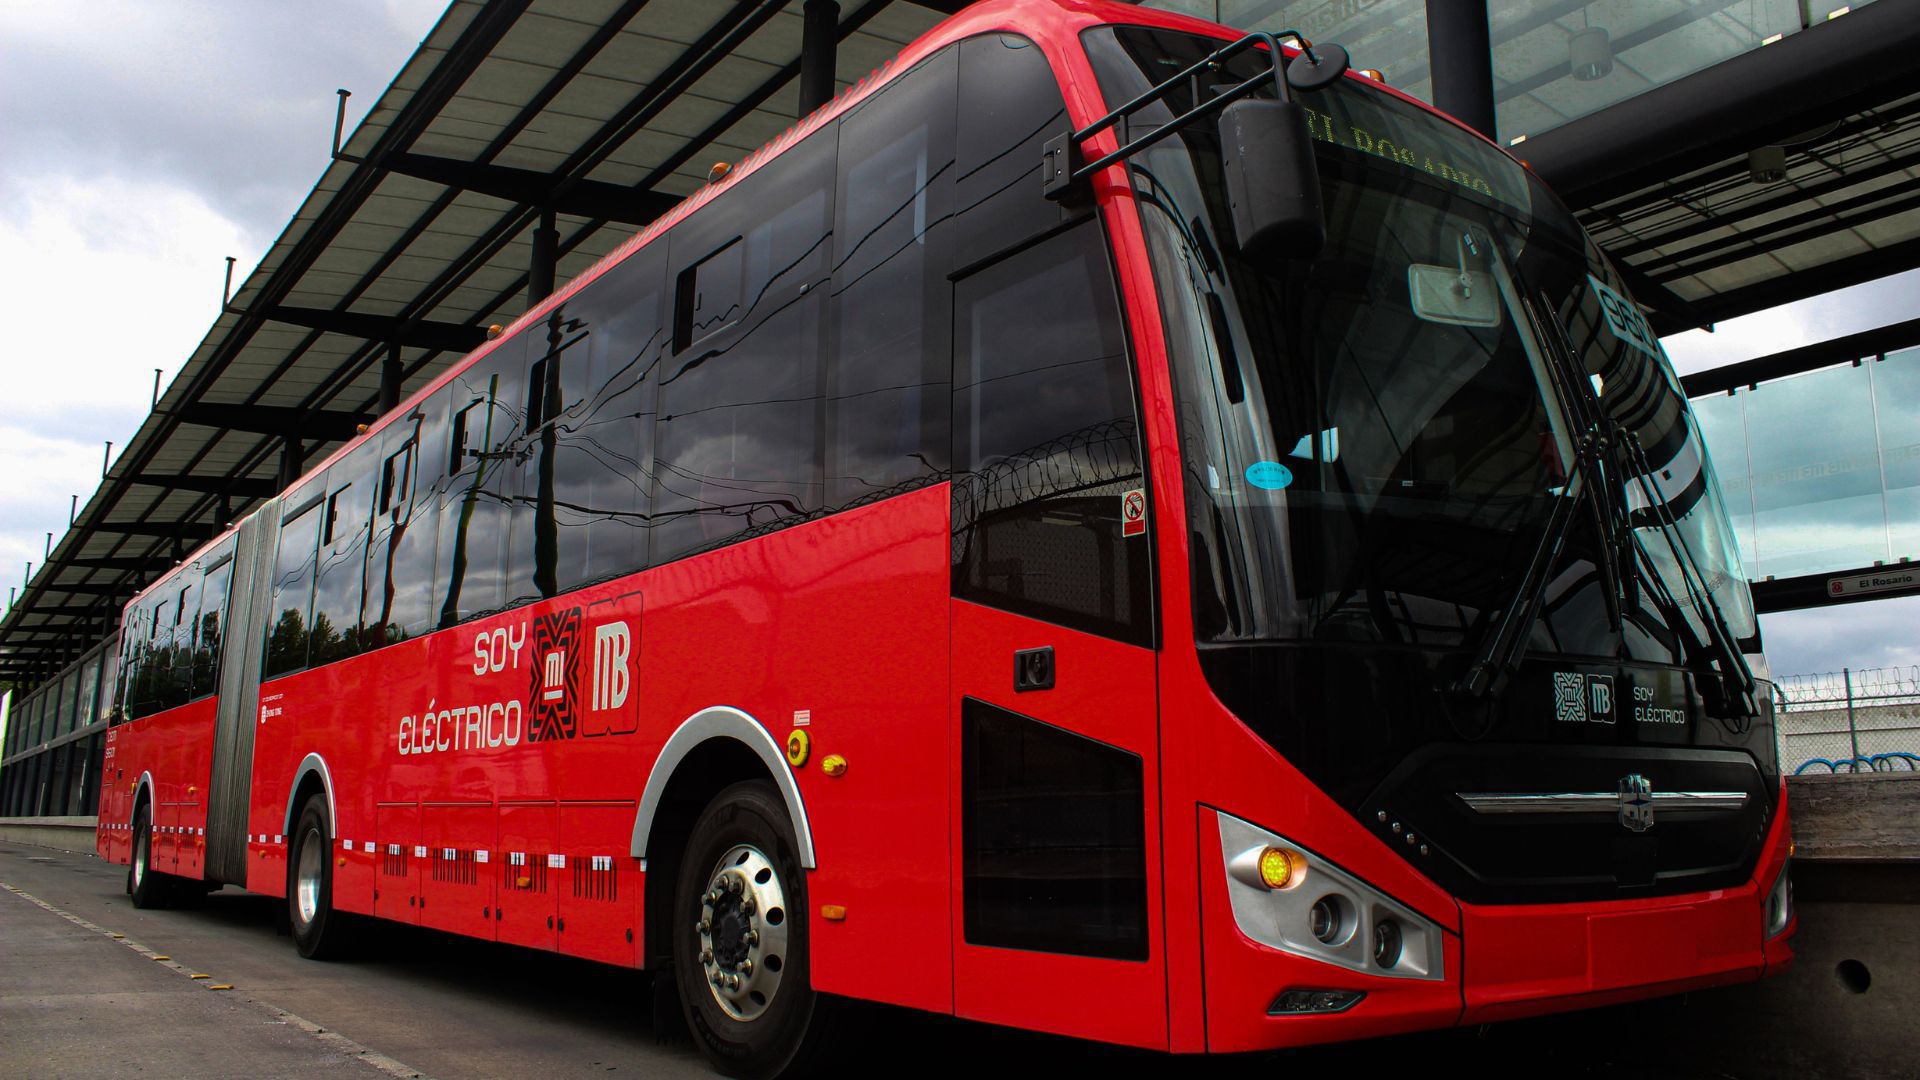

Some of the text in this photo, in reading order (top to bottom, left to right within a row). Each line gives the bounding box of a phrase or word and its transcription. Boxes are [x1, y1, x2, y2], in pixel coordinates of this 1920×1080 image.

[1859, 574, 1913, 588] El Rosario
[473, 621, 527, 676] SOY
[592, 620, 631, 711] MB
[1633, 686, 1654, 702] SOY
[398, 698, 522, 755] ELÉCTRICO
[1634, 703, 1685, 724] ELÉCTRICO
